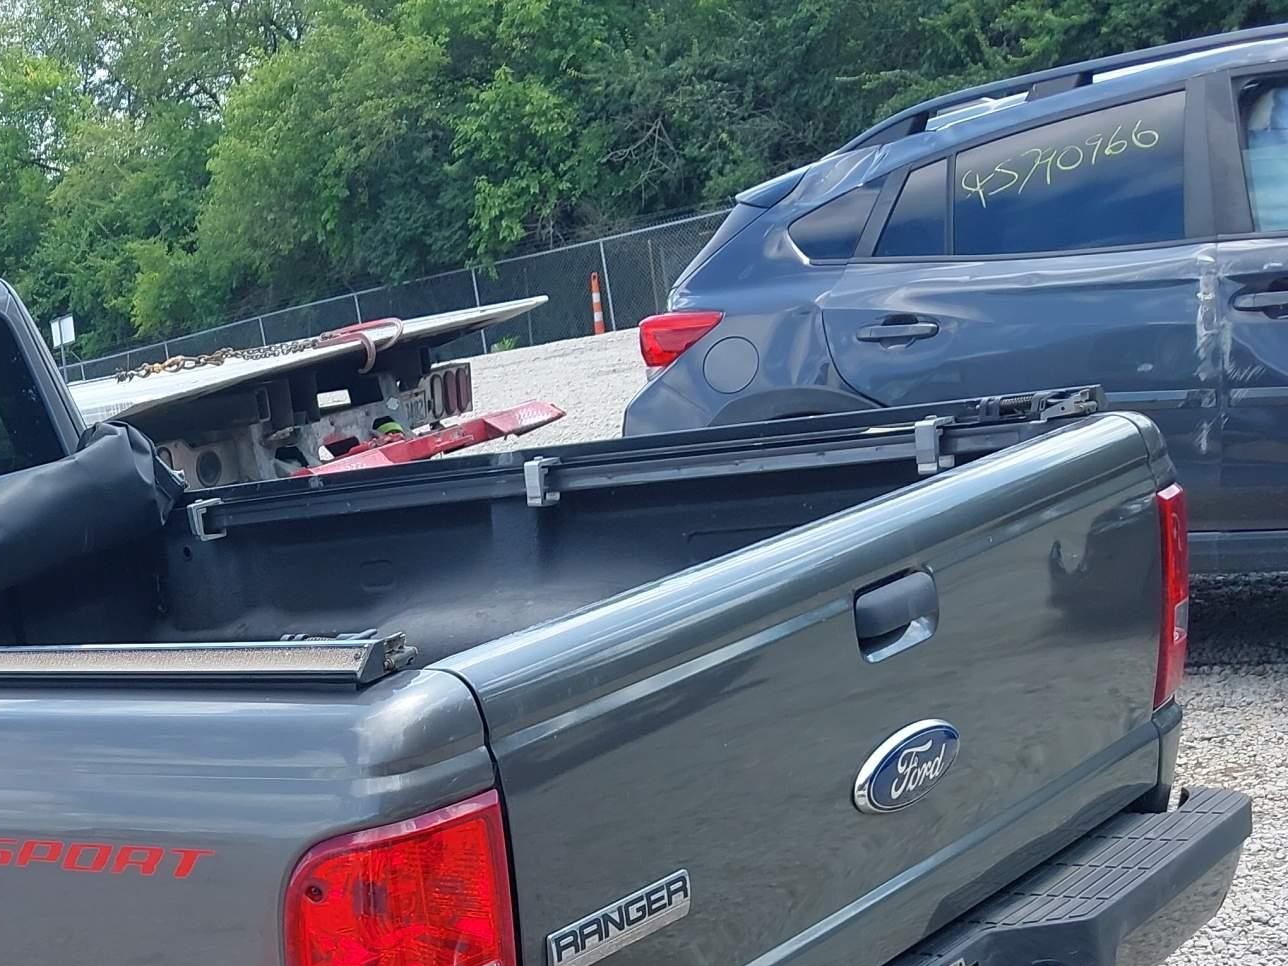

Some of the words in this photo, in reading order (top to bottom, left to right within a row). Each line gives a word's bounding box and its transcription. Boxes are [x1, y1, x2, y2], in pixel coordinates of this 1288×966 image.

[961, 120, 1159, 208] 45790966
[890, 739, 947, 800] Ford
[554, 875, 690, 963] RANGER
